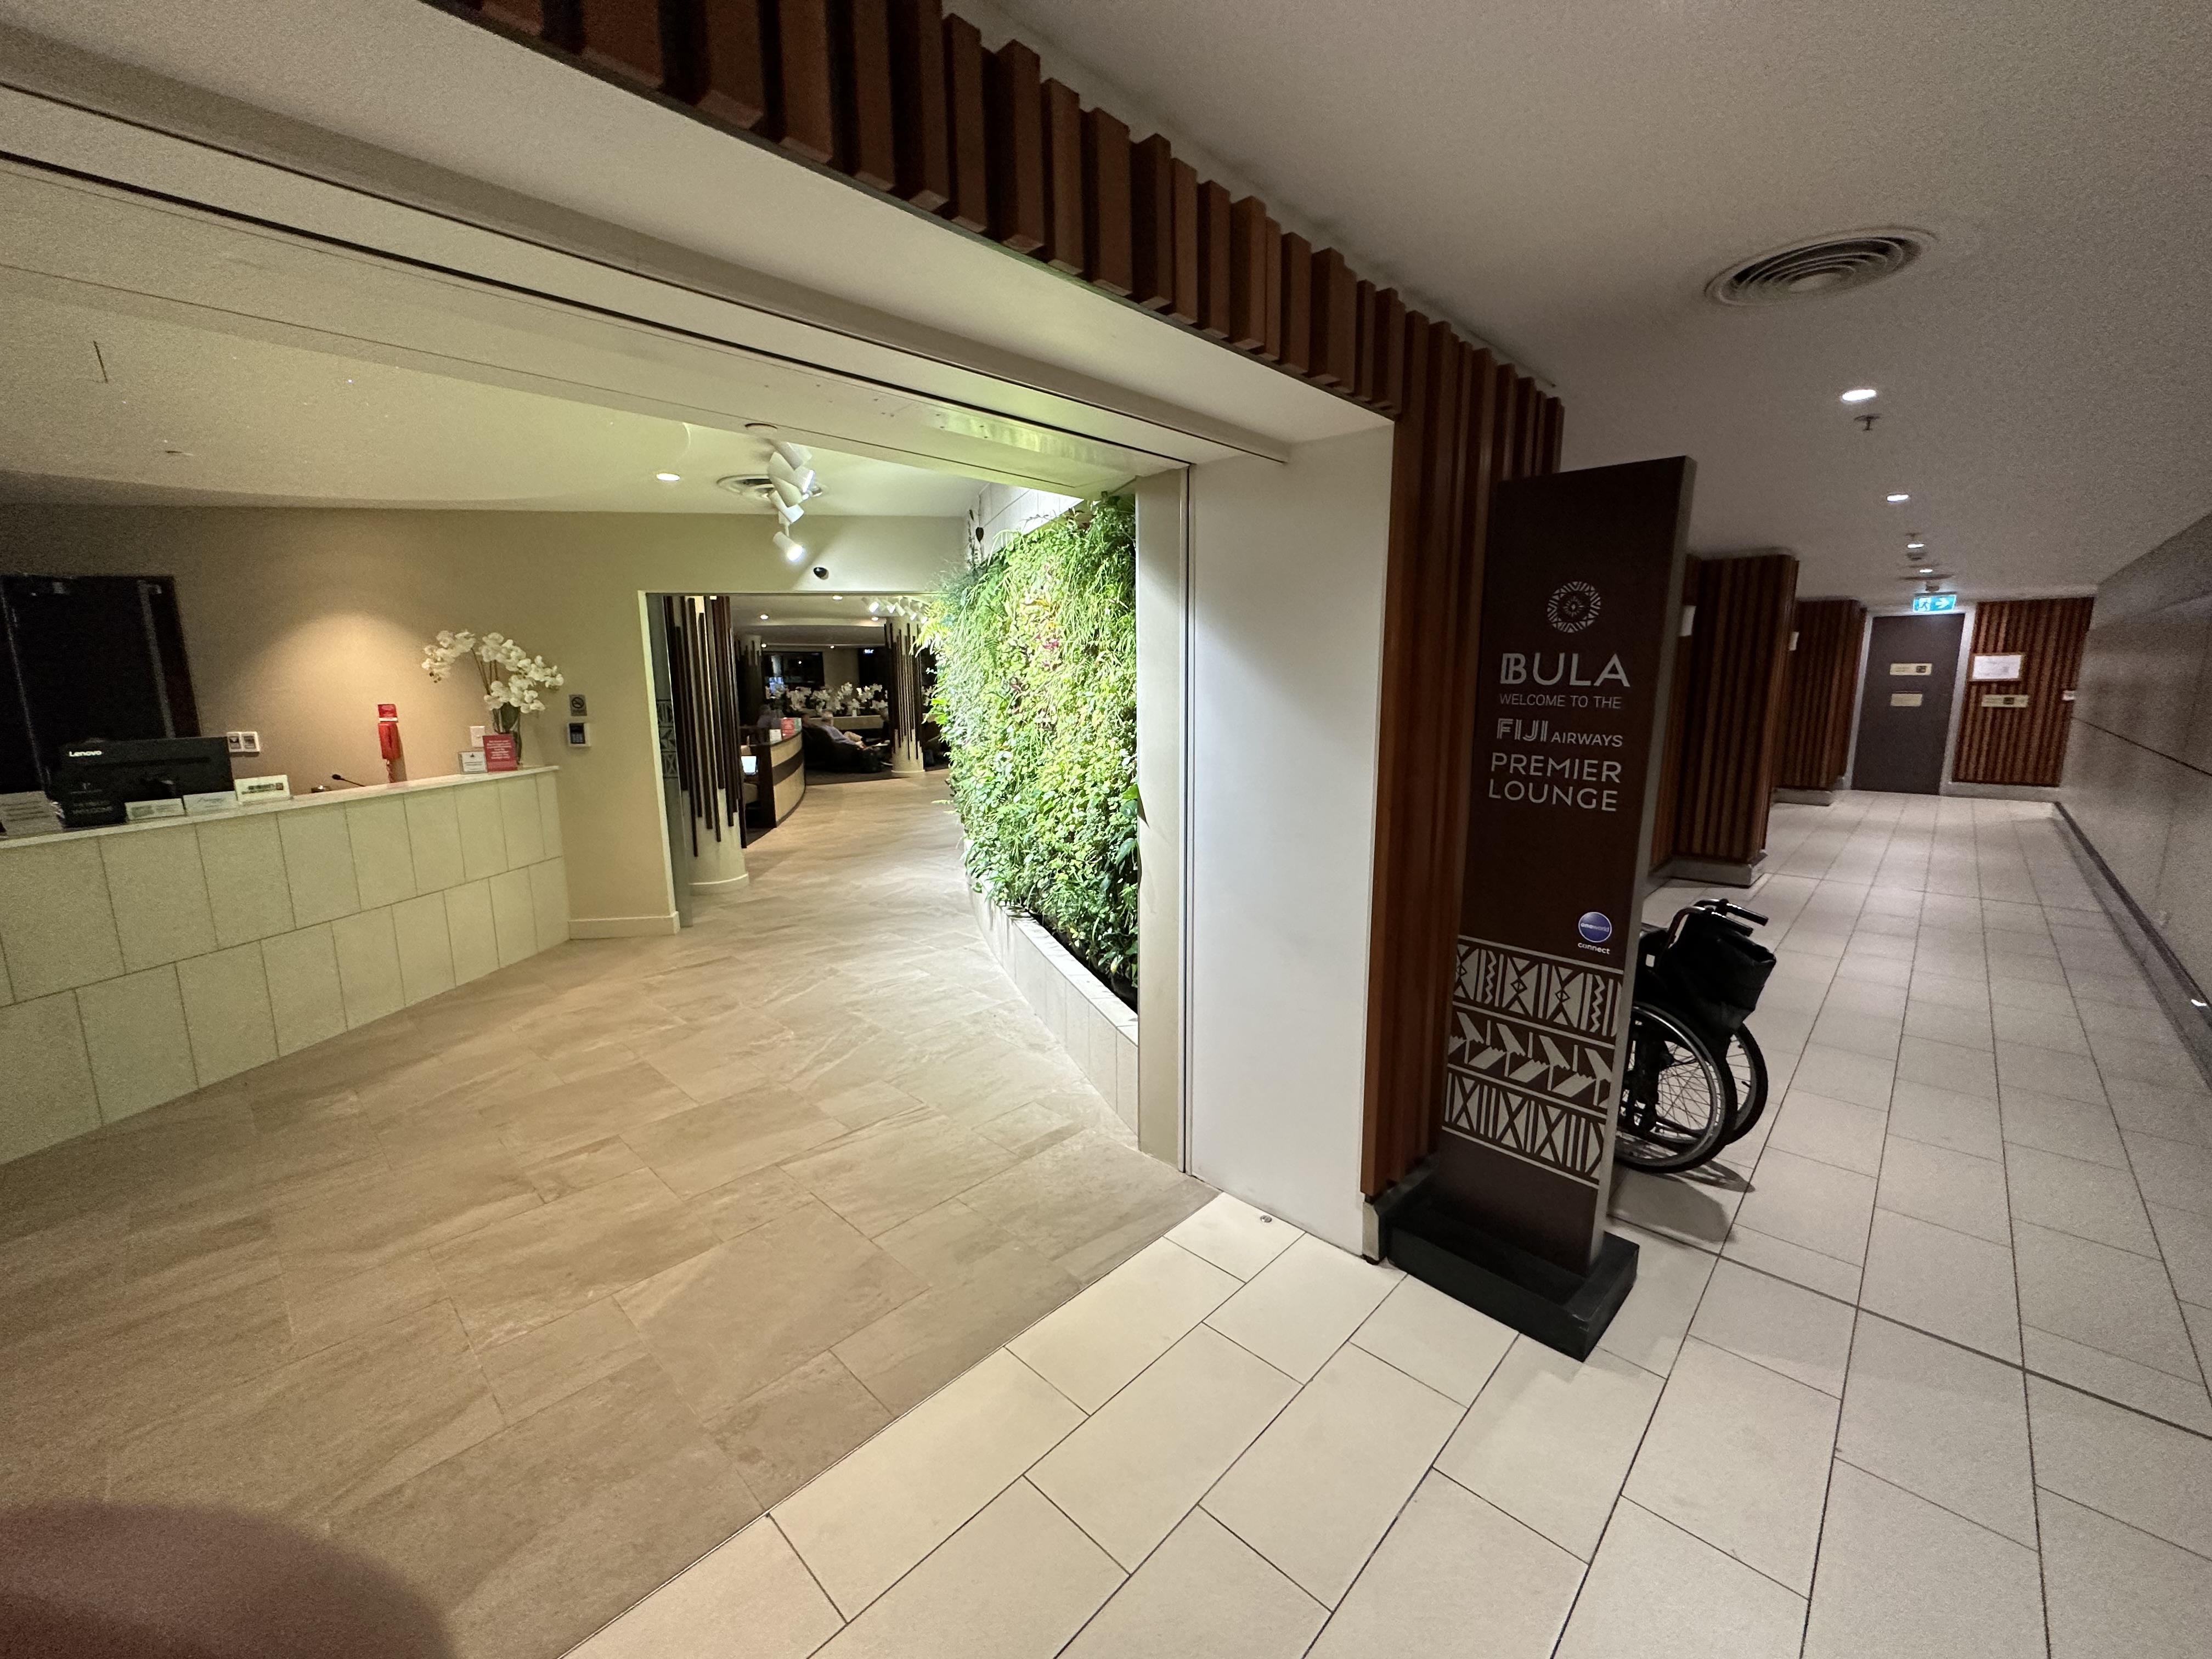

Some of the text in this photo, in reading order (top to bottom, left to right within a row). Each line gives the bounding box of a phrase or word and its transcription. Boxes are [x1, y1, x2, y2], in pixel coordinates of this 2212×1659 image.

[1499, 652, 1631, 687] BULA
[1499, 693, 1622, 709] WELCOME TO THE
[1496, 718, 1623, 747] FIJI AIRWAYS
[1491, 752, 1622, 783] PREMIER
[1488, 778, 1618, 812] LOUNGE
[1580, 922, 1610, 933] oneworld
[1577, 943, 1611, 955] connect
